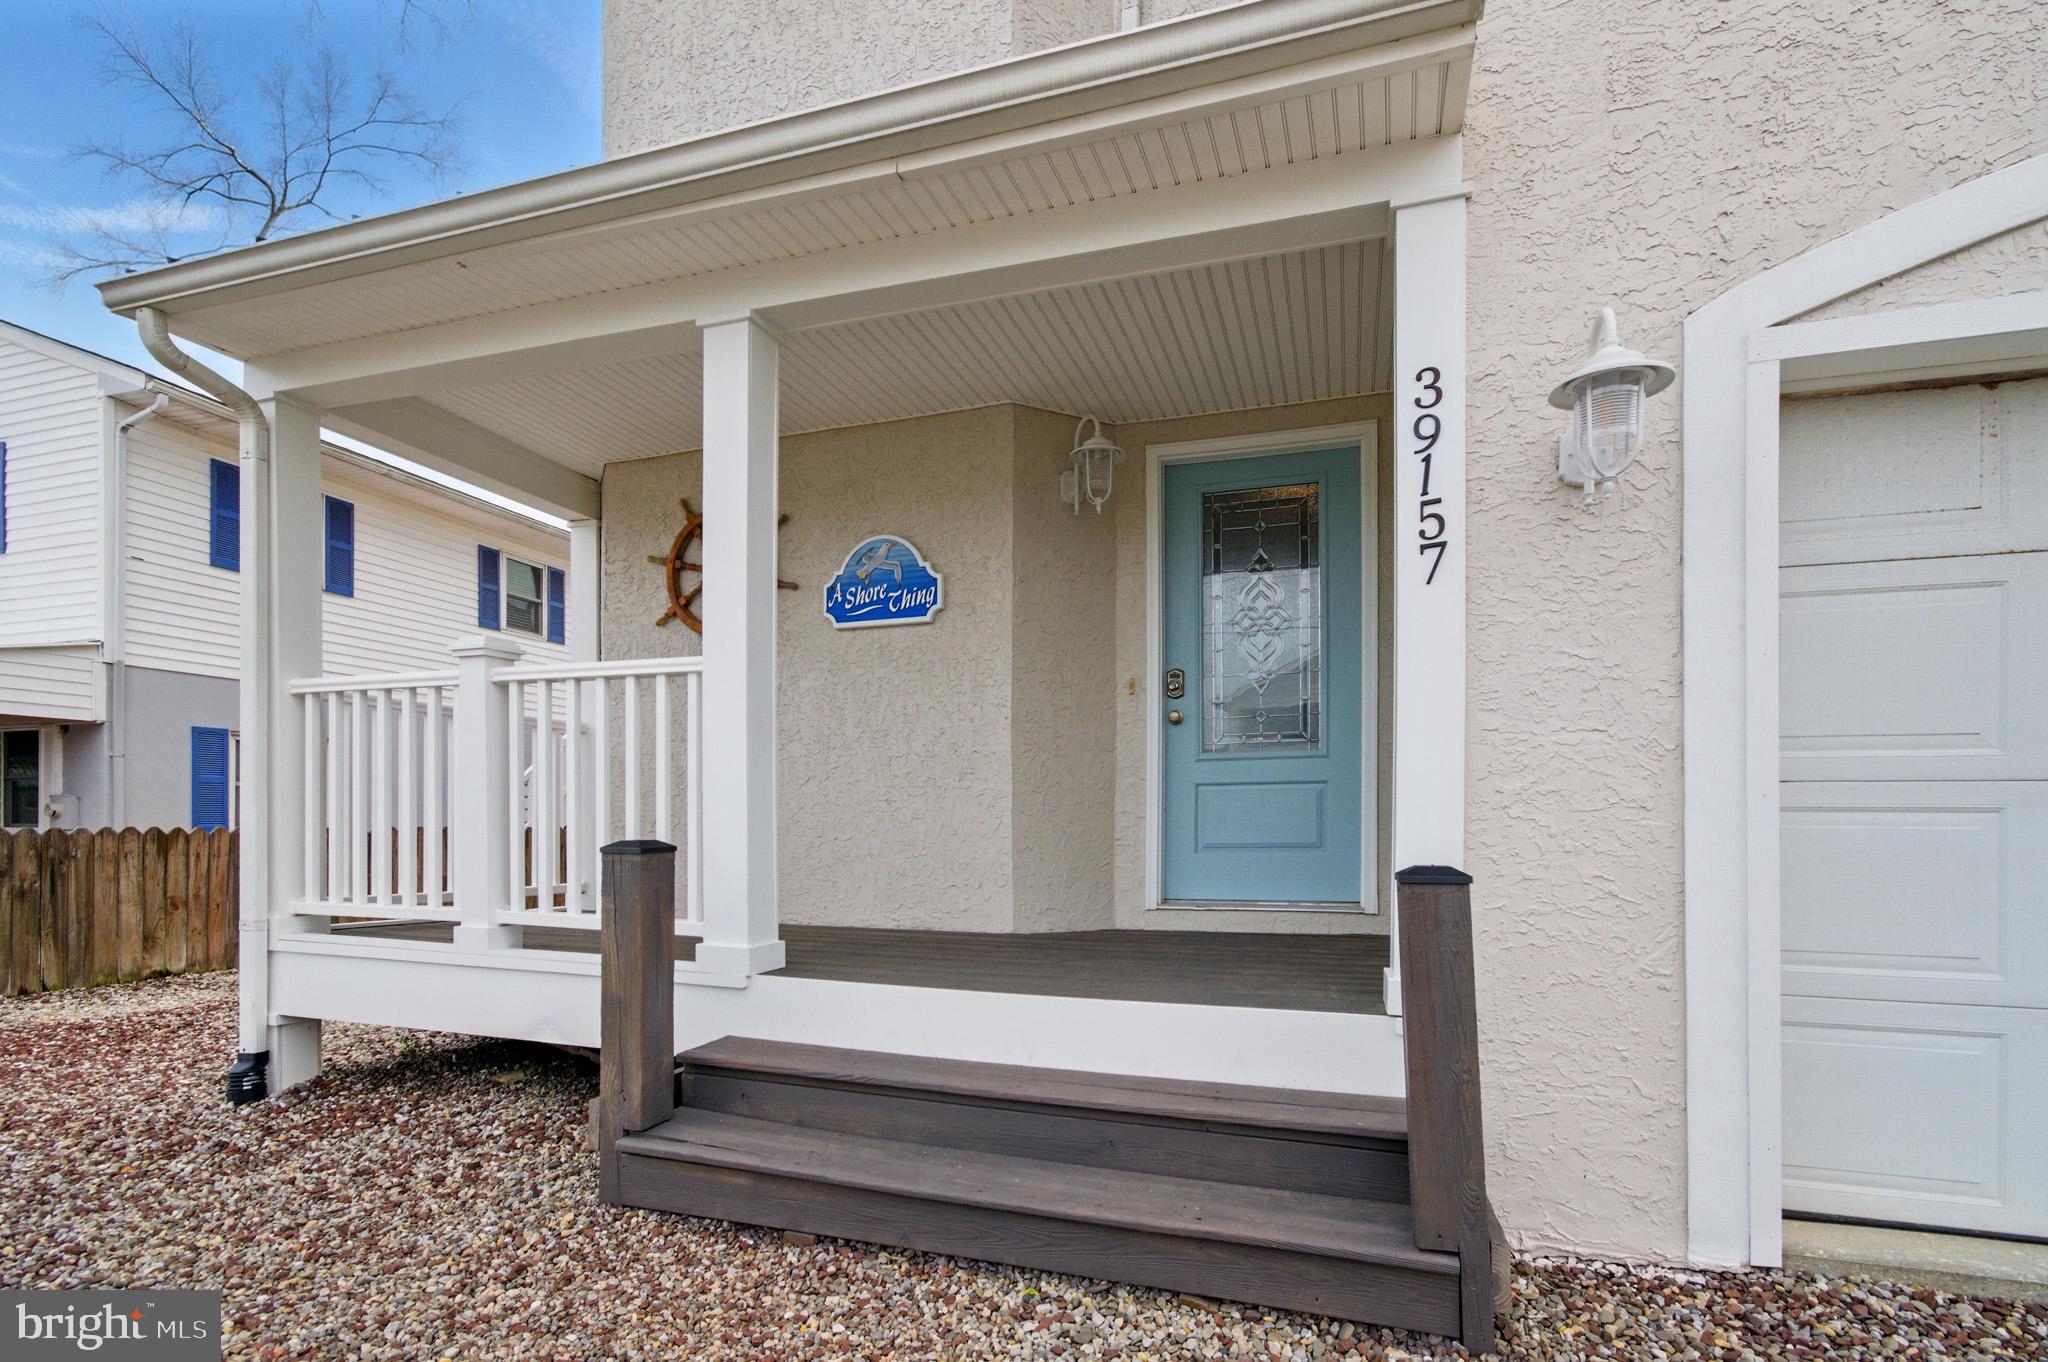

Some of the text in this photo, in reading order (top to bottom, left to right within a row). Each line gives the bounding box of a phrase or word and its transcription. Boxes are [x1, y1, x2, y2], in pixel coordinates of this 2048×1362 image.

[1413, 366, 1448, 585] 39157
[828, 582, 936, 613] A Shore Thing
